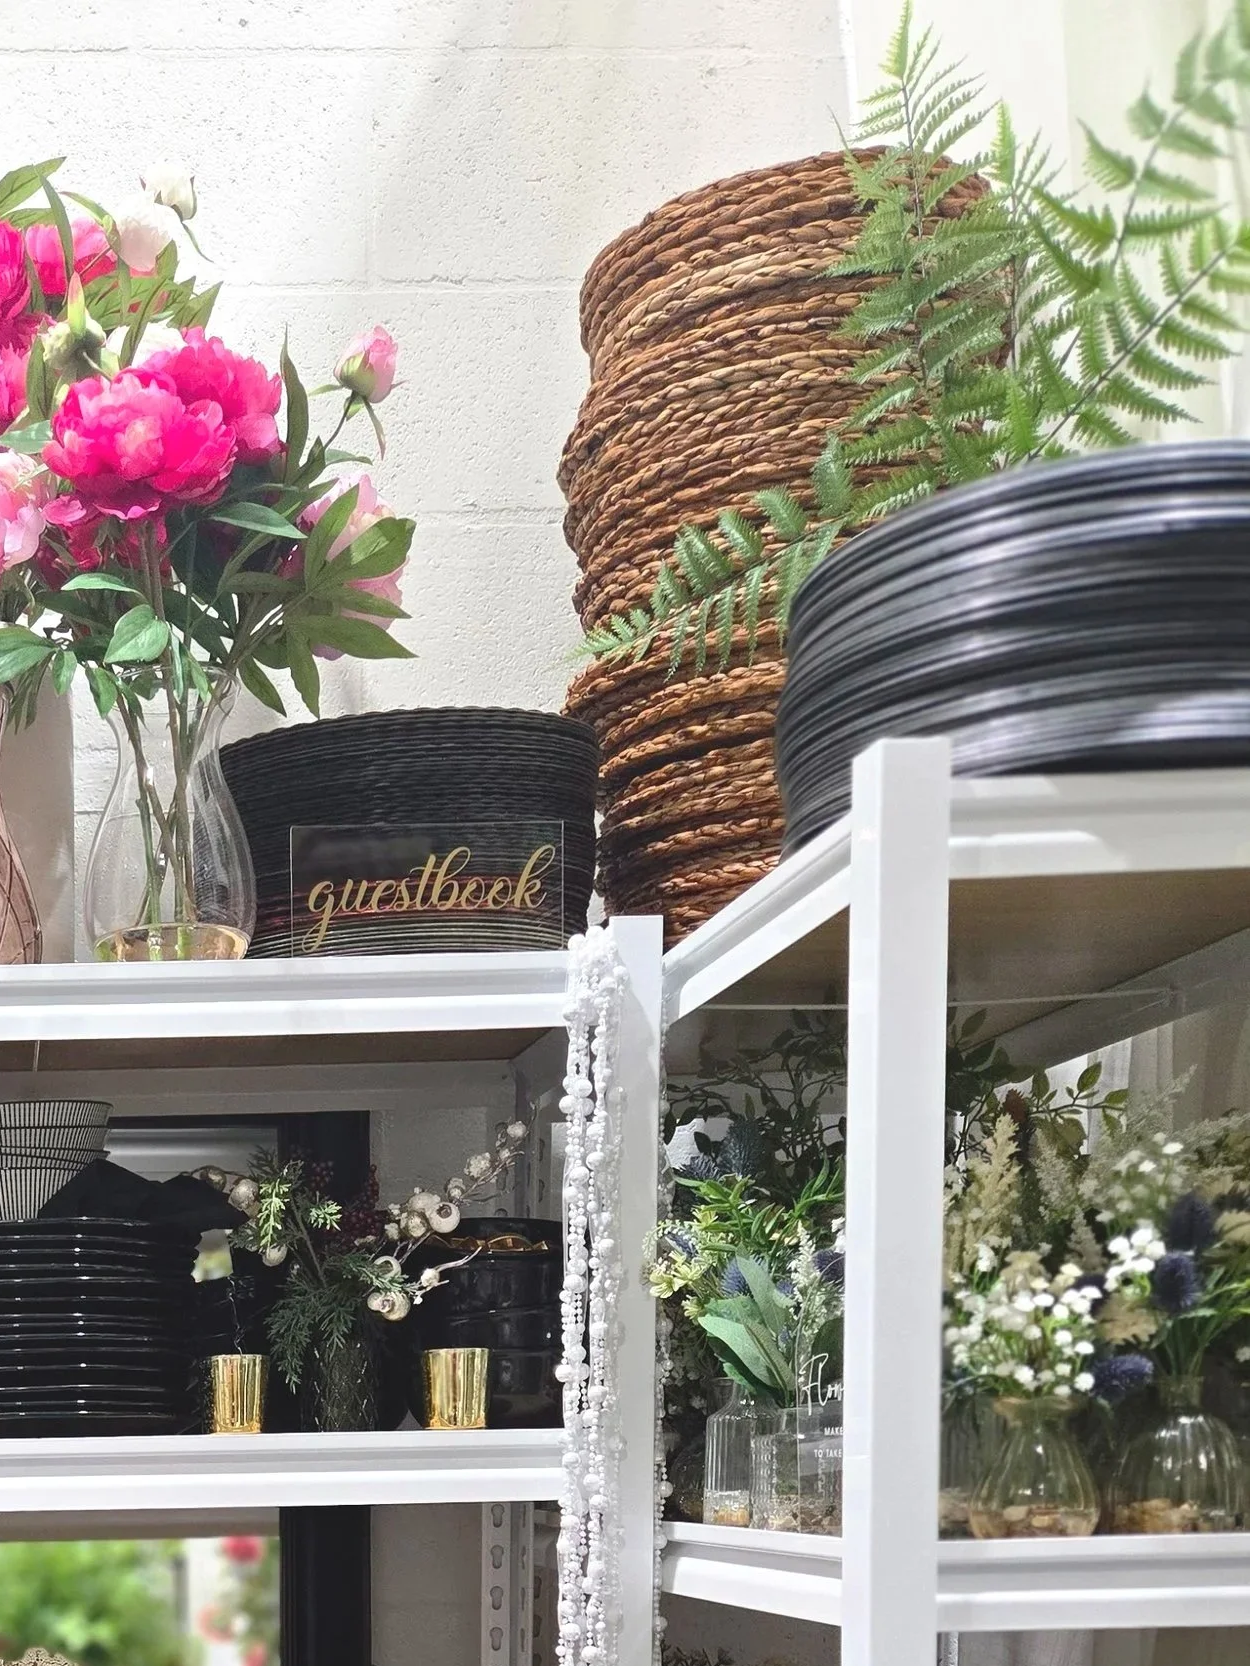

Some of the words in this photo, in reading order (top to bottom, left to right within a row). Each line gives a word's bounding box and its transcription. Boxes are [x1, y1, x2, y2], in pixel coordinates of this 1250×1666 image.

[302, 845, 556, 952] guestbook
[814, 1449, 823, 1458] TO
[826, 1449, 843, 1458] TAKE
